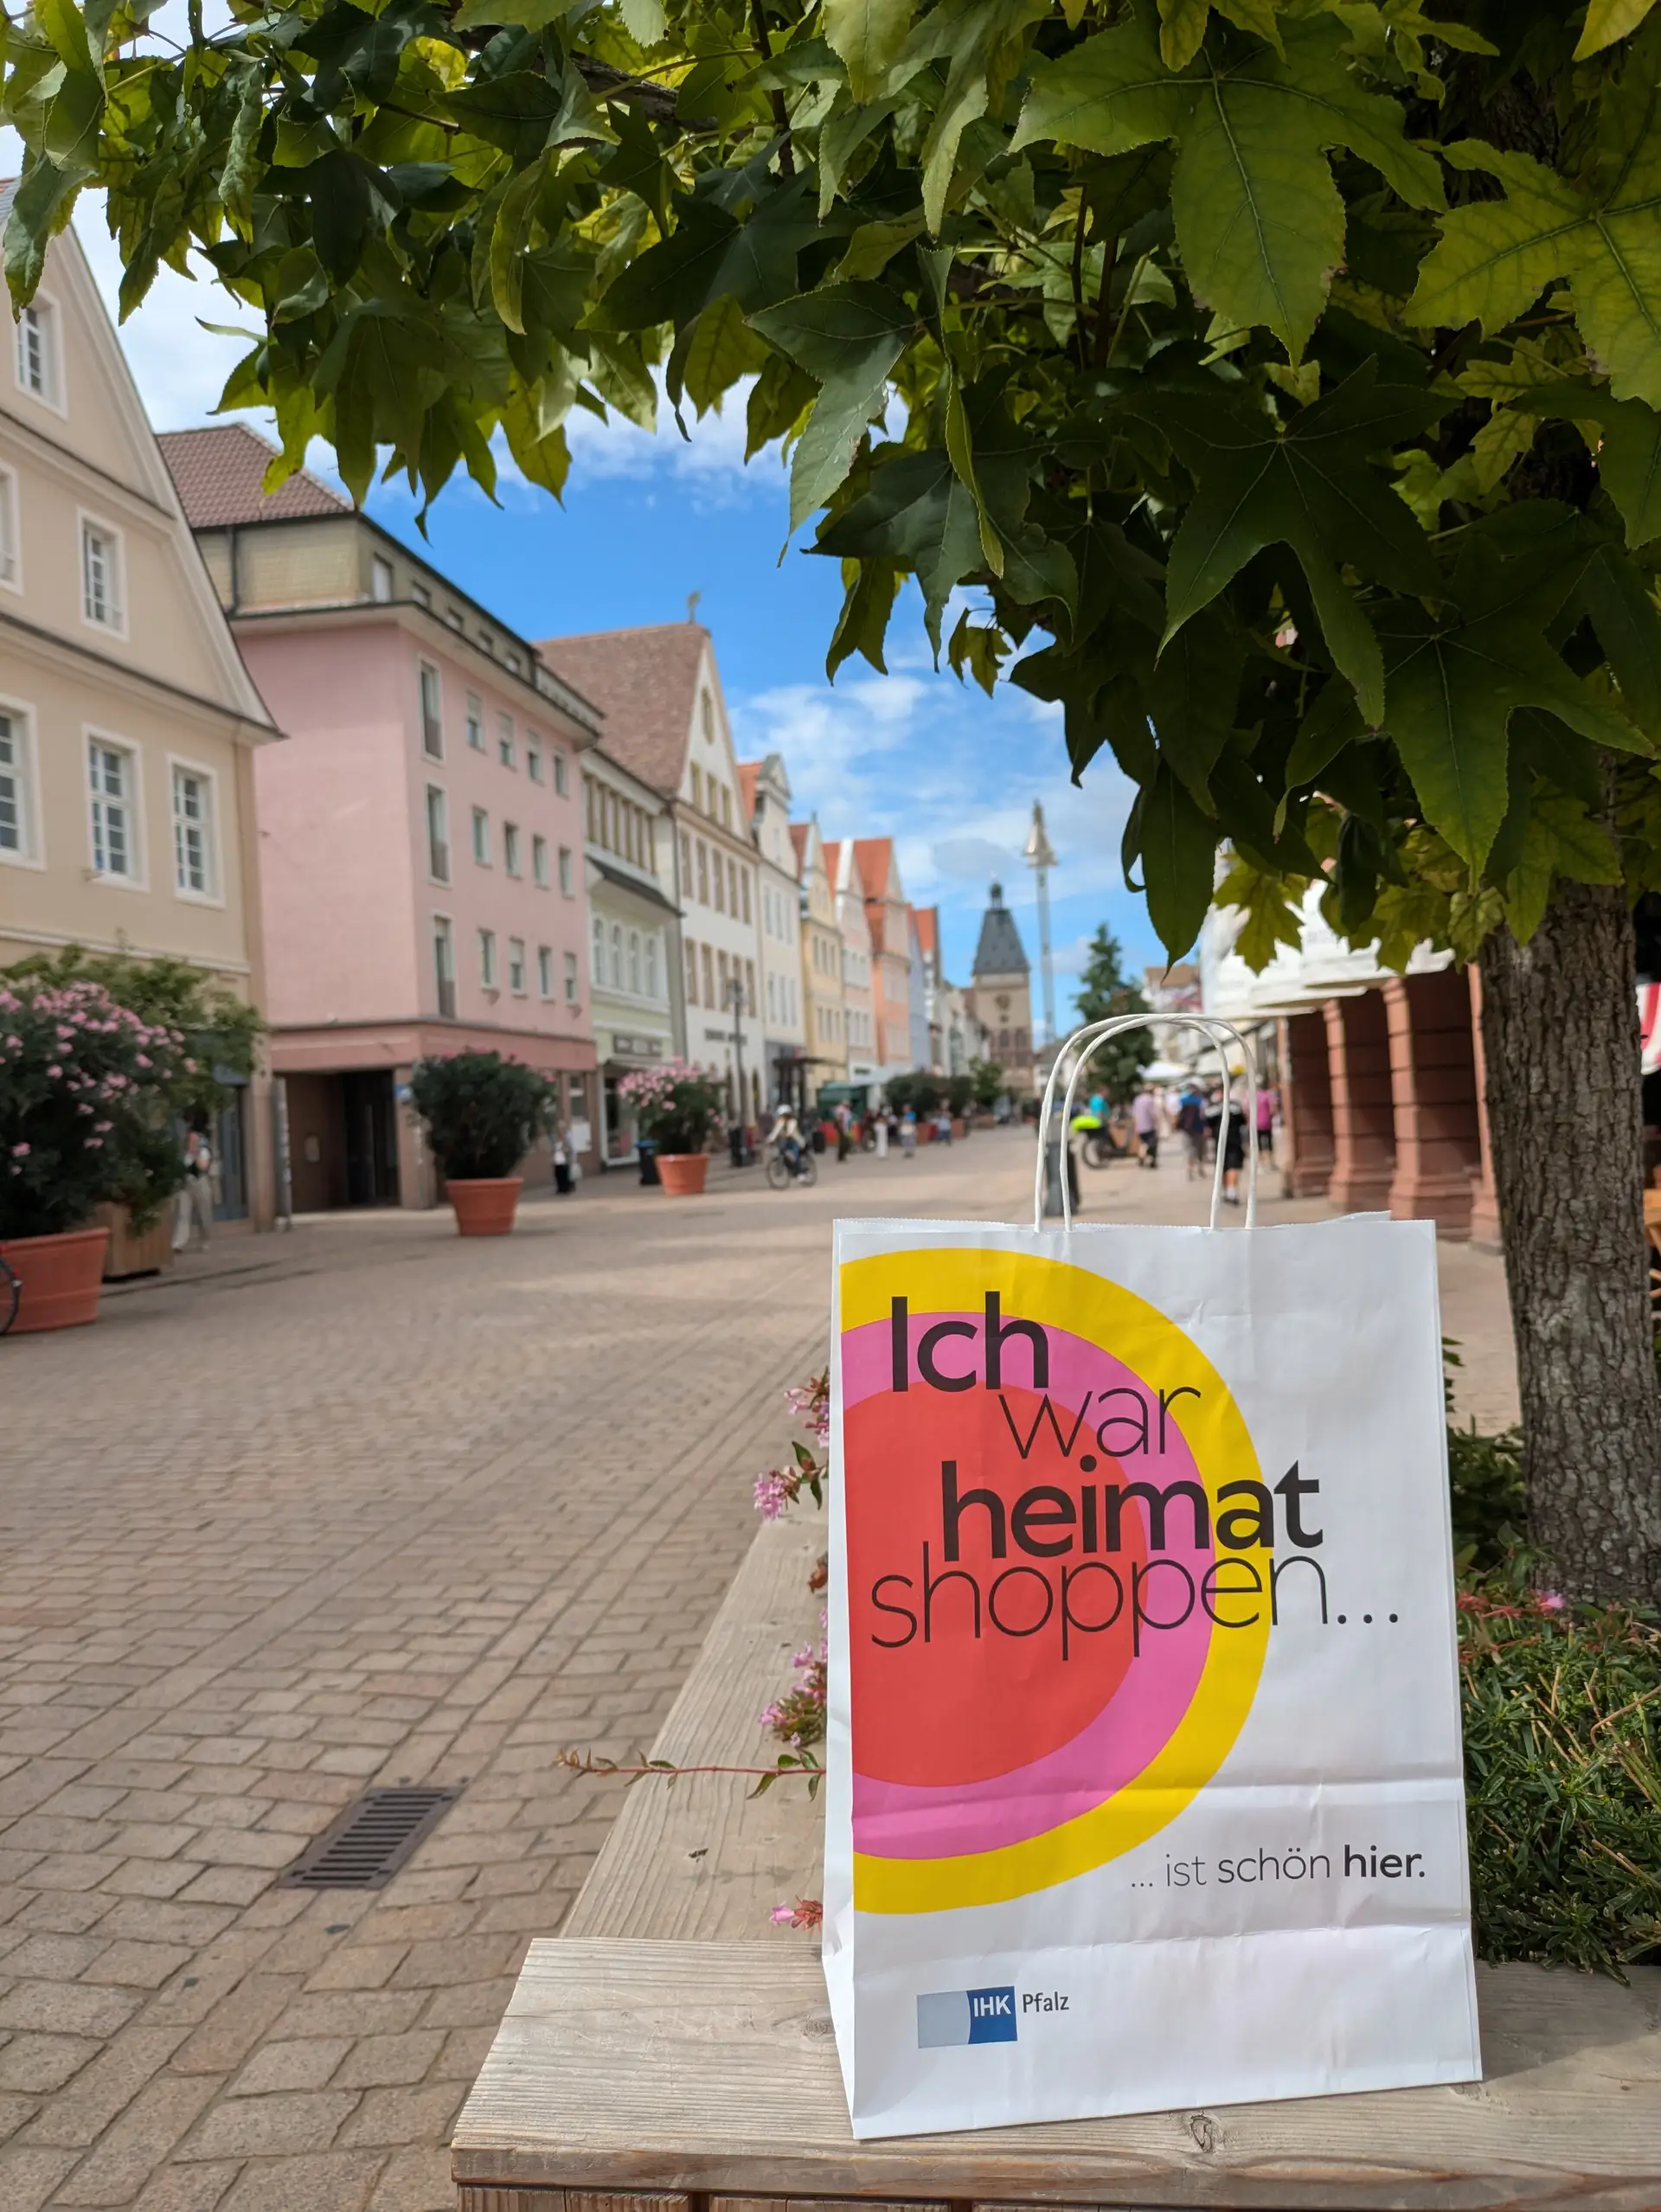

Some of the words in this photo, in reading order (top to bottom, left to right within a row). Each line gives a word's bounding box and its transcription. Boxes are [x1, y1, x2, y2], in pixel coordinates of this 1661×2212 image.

[891, 1291, 1049, 1392] Ich
[998, 1386, 1202, 1459] war
[941, 1454, 1324, 1561] heimat
[871, 1542, 1399, 1661] shoppen...
[1165, 1854, 1208, 1888] ist
[1217, 1847, 1331, 1884] schön
[1344, 1843, 1427, 1879] hier.
[973, 1994, 1012, 2017] IHK
[1022, 1991, 1070, 2013] Pfalz
